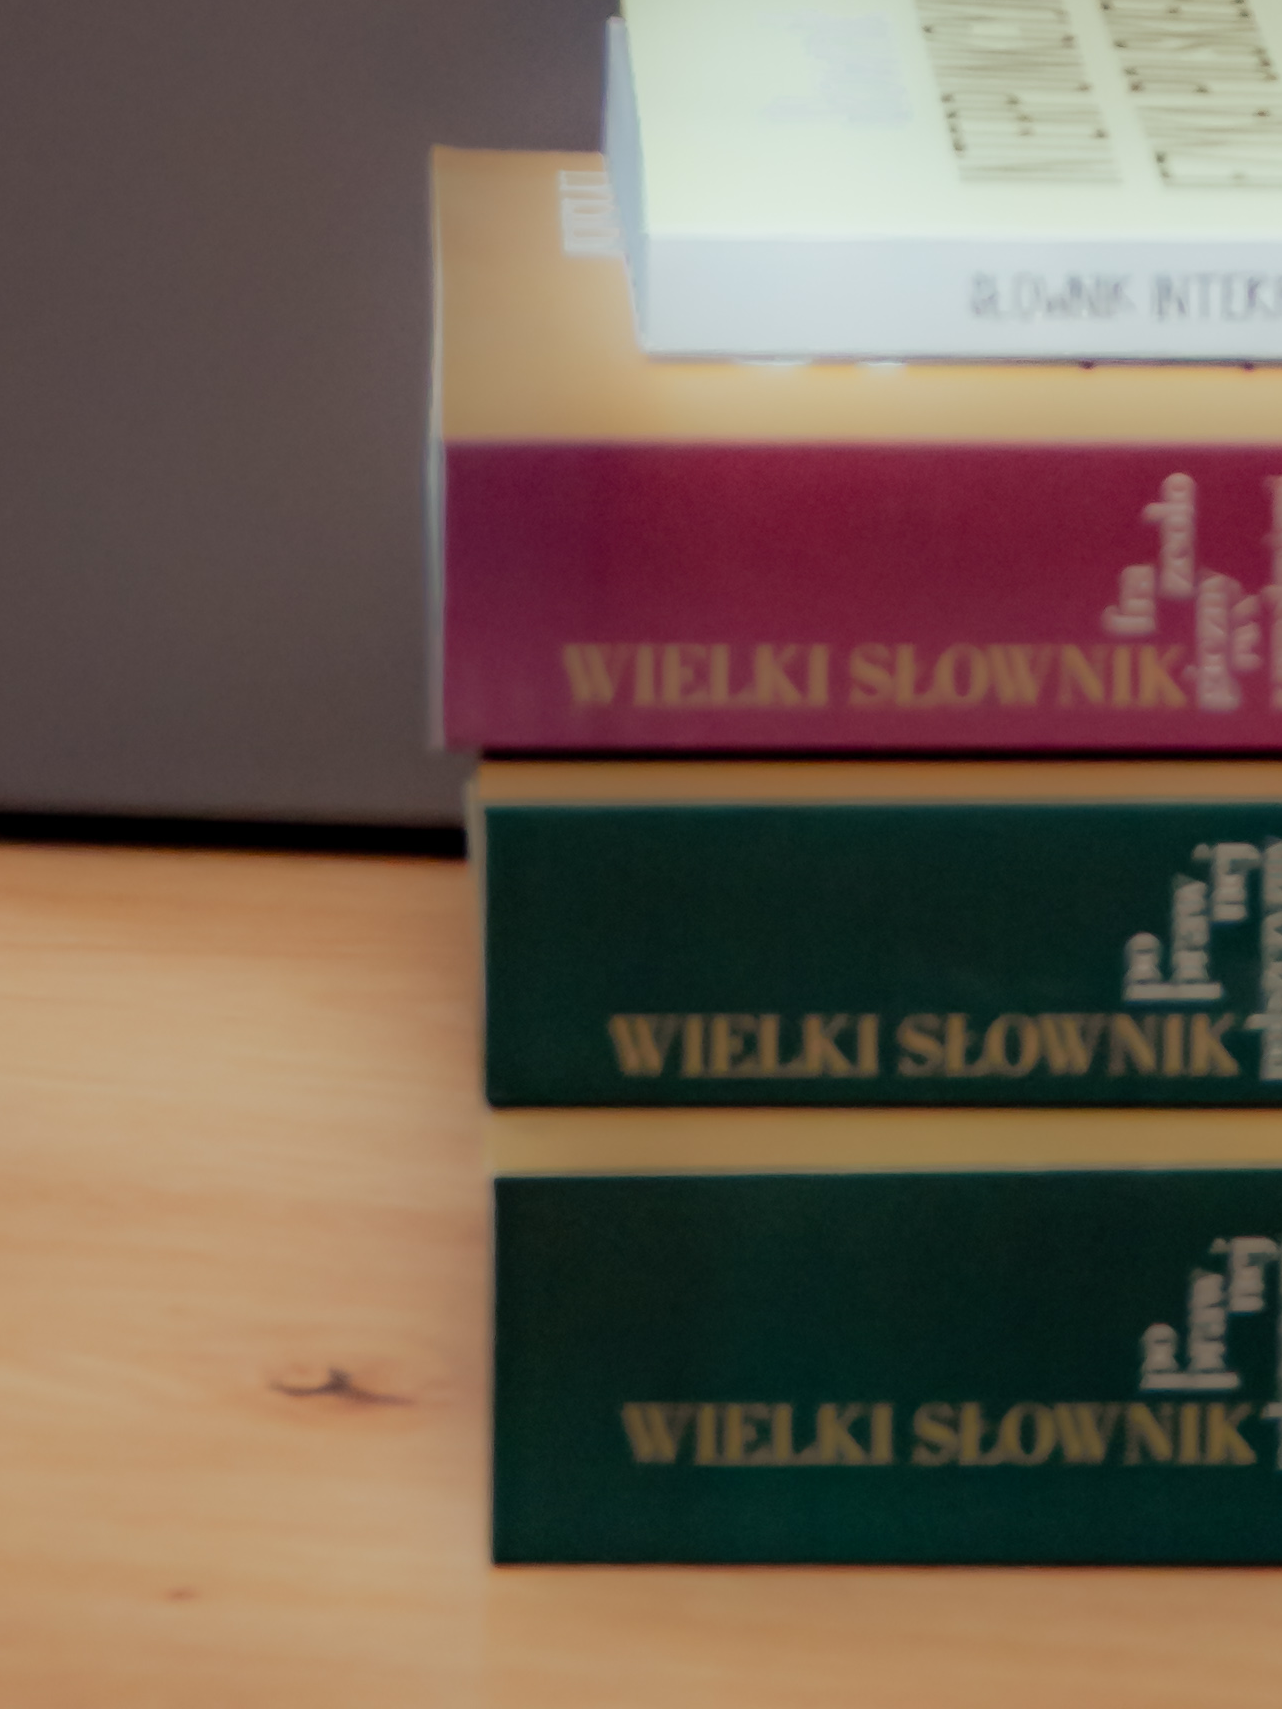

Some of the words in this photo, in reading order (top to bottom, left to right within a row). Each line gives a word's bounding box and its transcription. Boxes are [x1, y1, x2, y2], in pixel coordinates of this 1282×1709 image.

[562, 643, 830, 709] WIELKI
[848, 643, 1188, 709] SŁOWNIK
[610, 1013, 882, 1079] WIELKI
[896, 1013, 1240, 1079] SŁOWNIK
[622, 1403, 896, 1467] WIELKI
[910, 1403, 1258, 1467] SŁOWNIK
